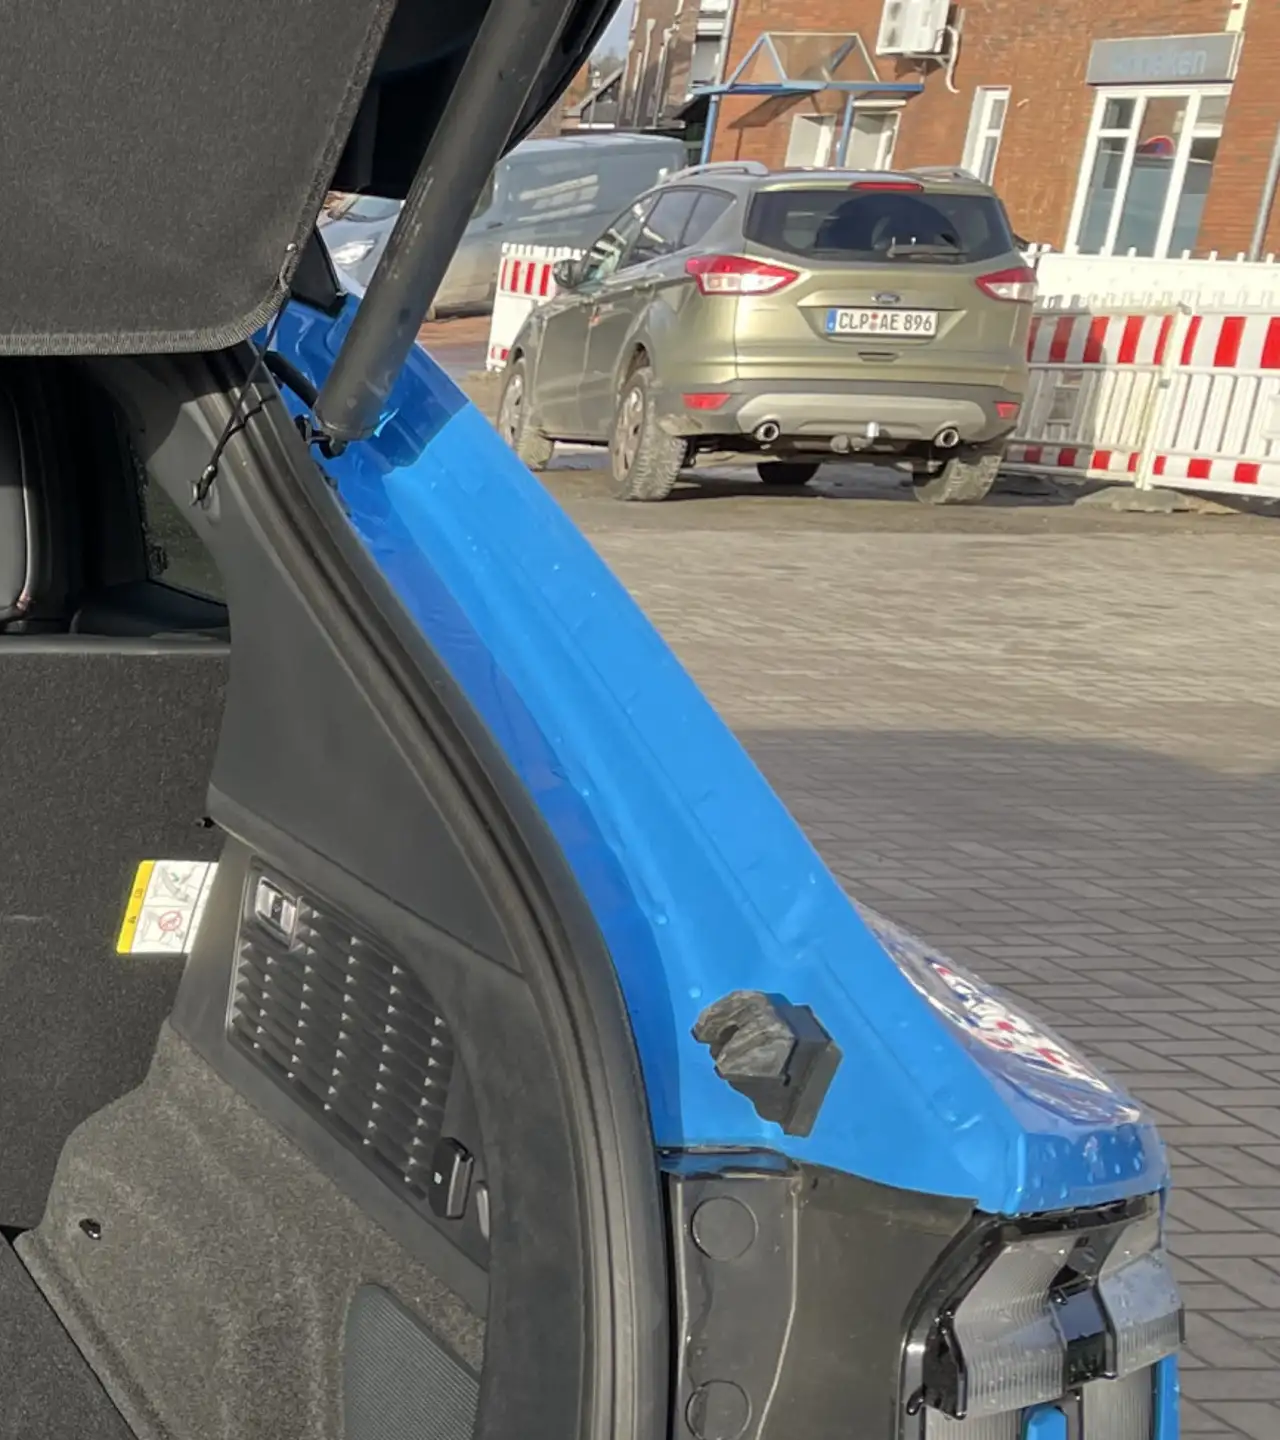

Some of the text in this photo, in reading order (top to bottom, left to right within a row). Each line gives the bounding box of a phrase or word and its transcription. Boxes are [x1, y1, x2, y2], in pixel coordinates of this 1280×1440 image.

[839, 312, 933, 331] CLP AE 896
